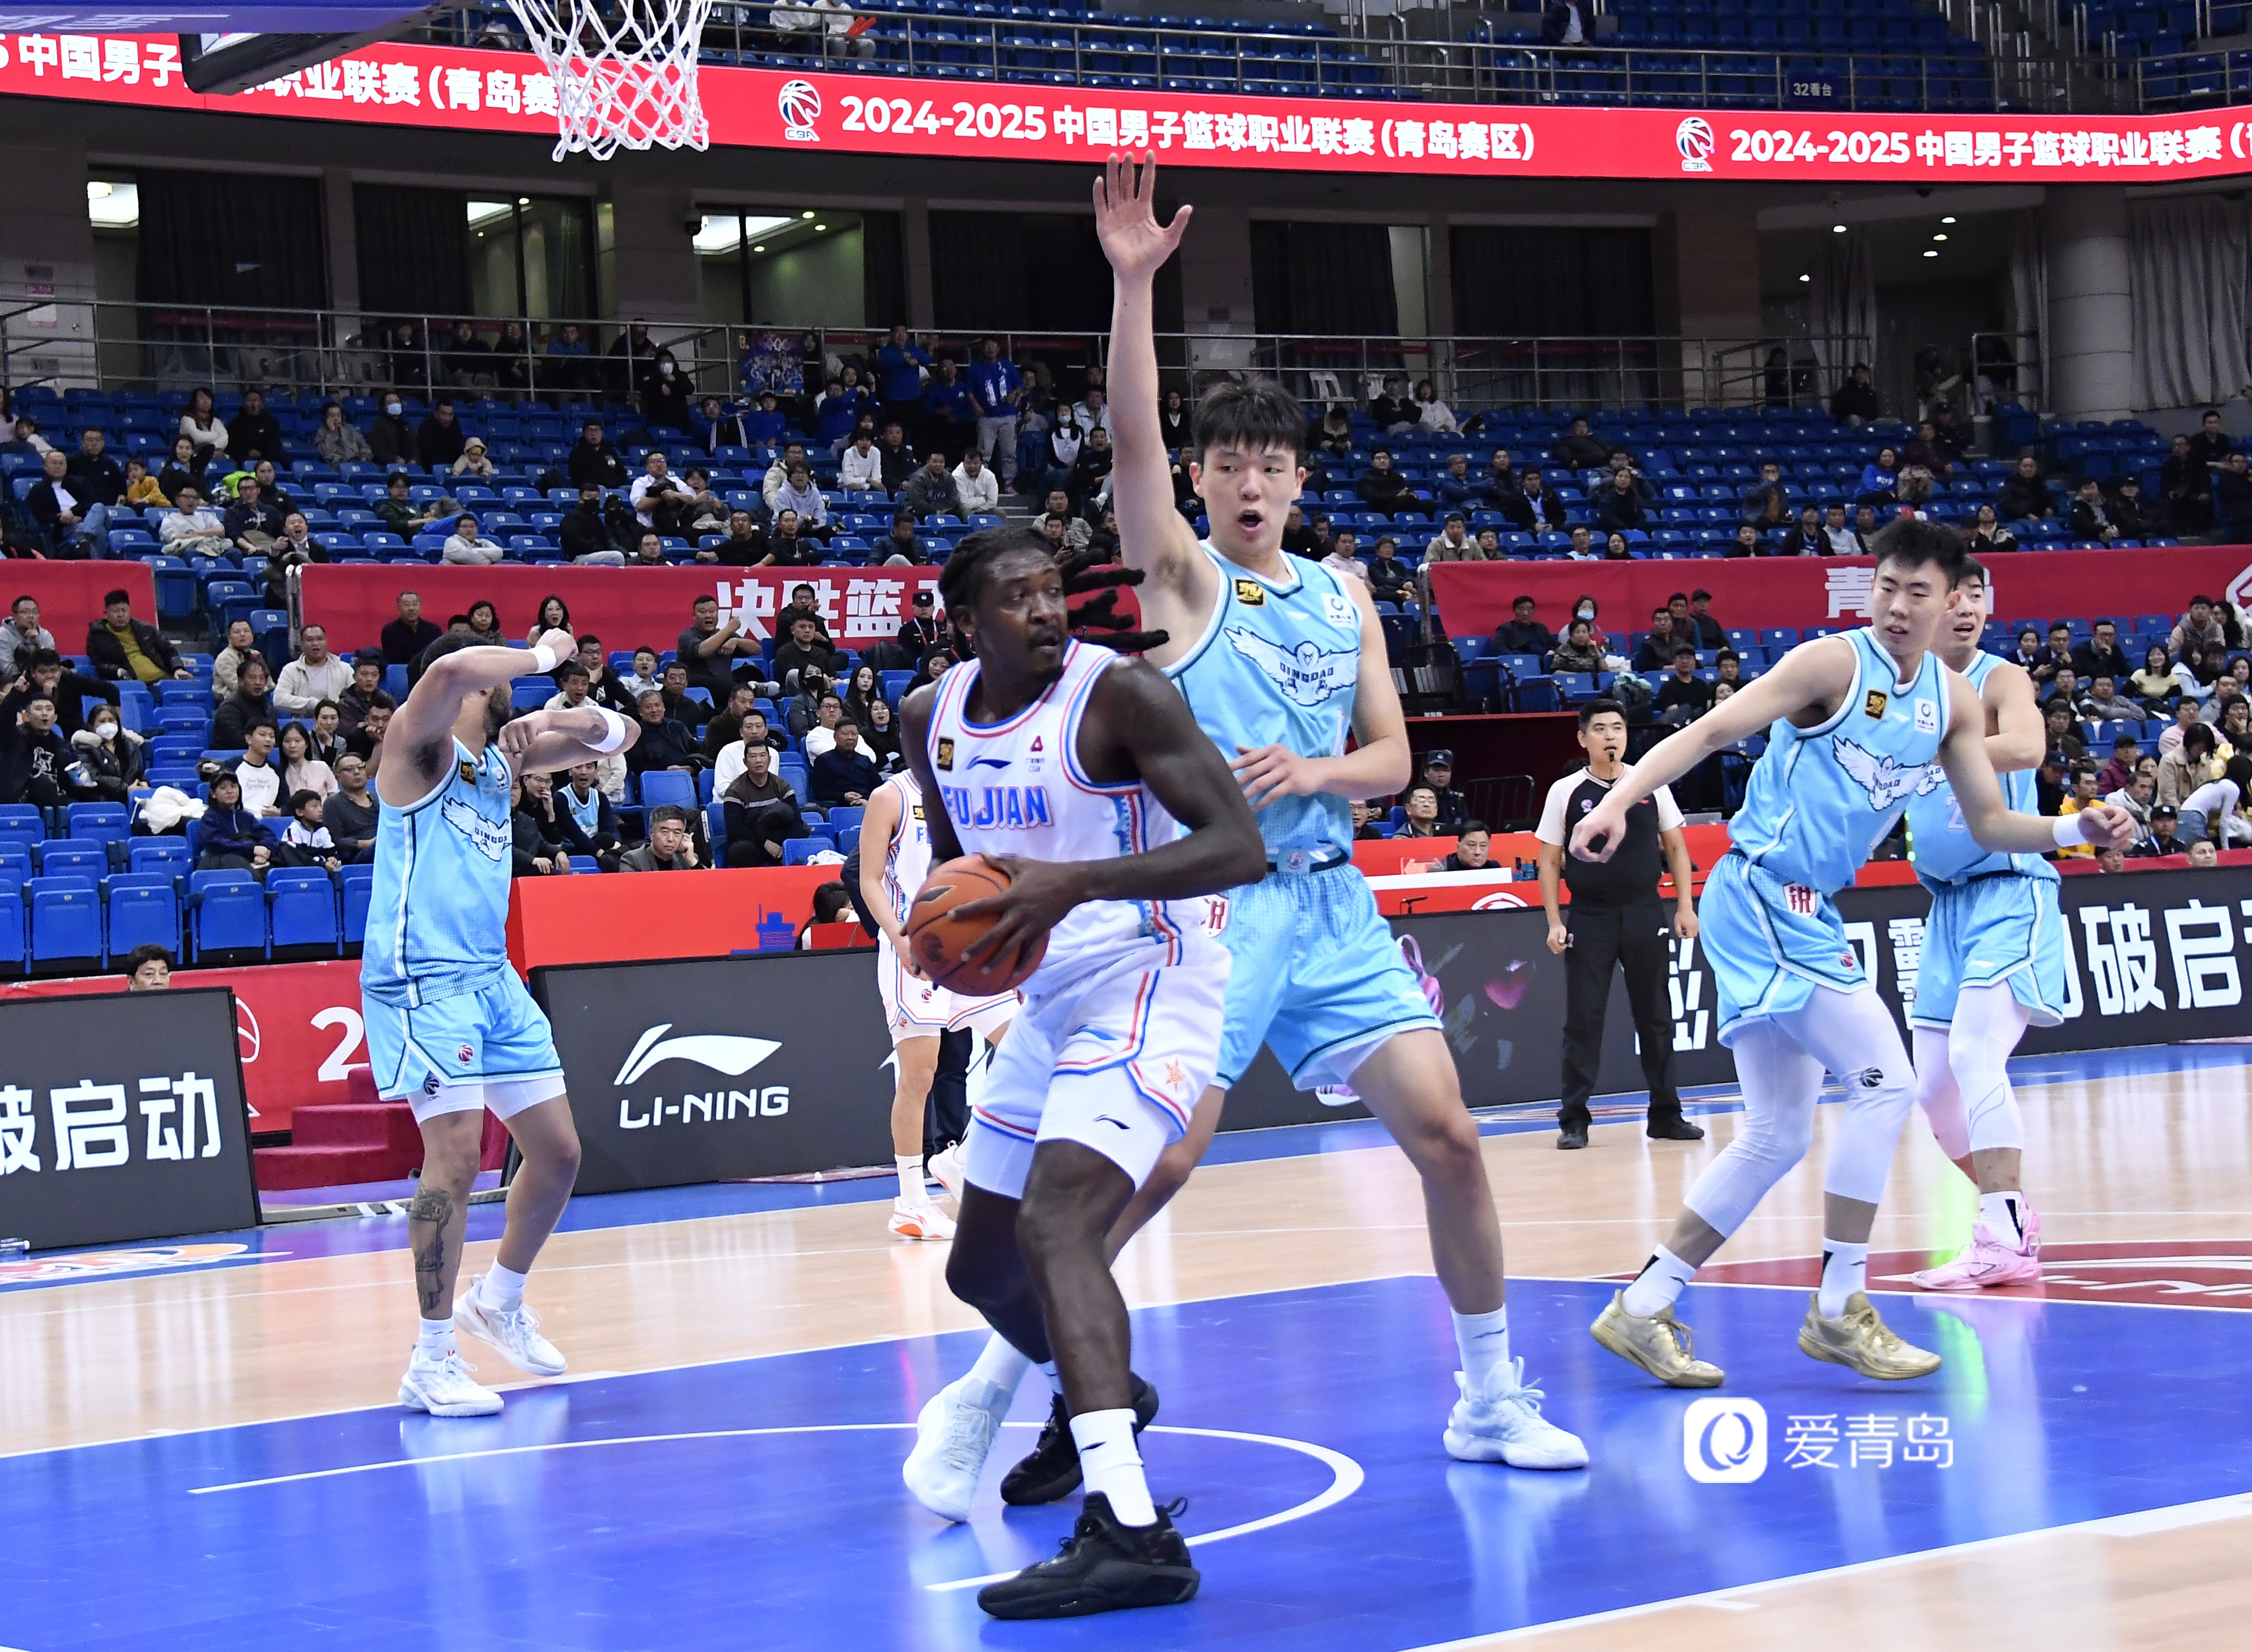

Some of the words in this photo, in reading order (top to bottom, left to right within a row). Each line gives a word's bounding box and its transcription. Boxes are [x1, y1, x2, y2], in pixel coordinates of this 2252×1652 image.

[840, 96, 1047, 140] 2024-2025
[1729, 129, 1910, 164] 2024-2025
[1915, 121, 2252, 168] 中国男子篮球职业联赛(
[1279, 661, 1334, 683] QINGDAO
[619, 1085, 790, 1129] LI-NING
